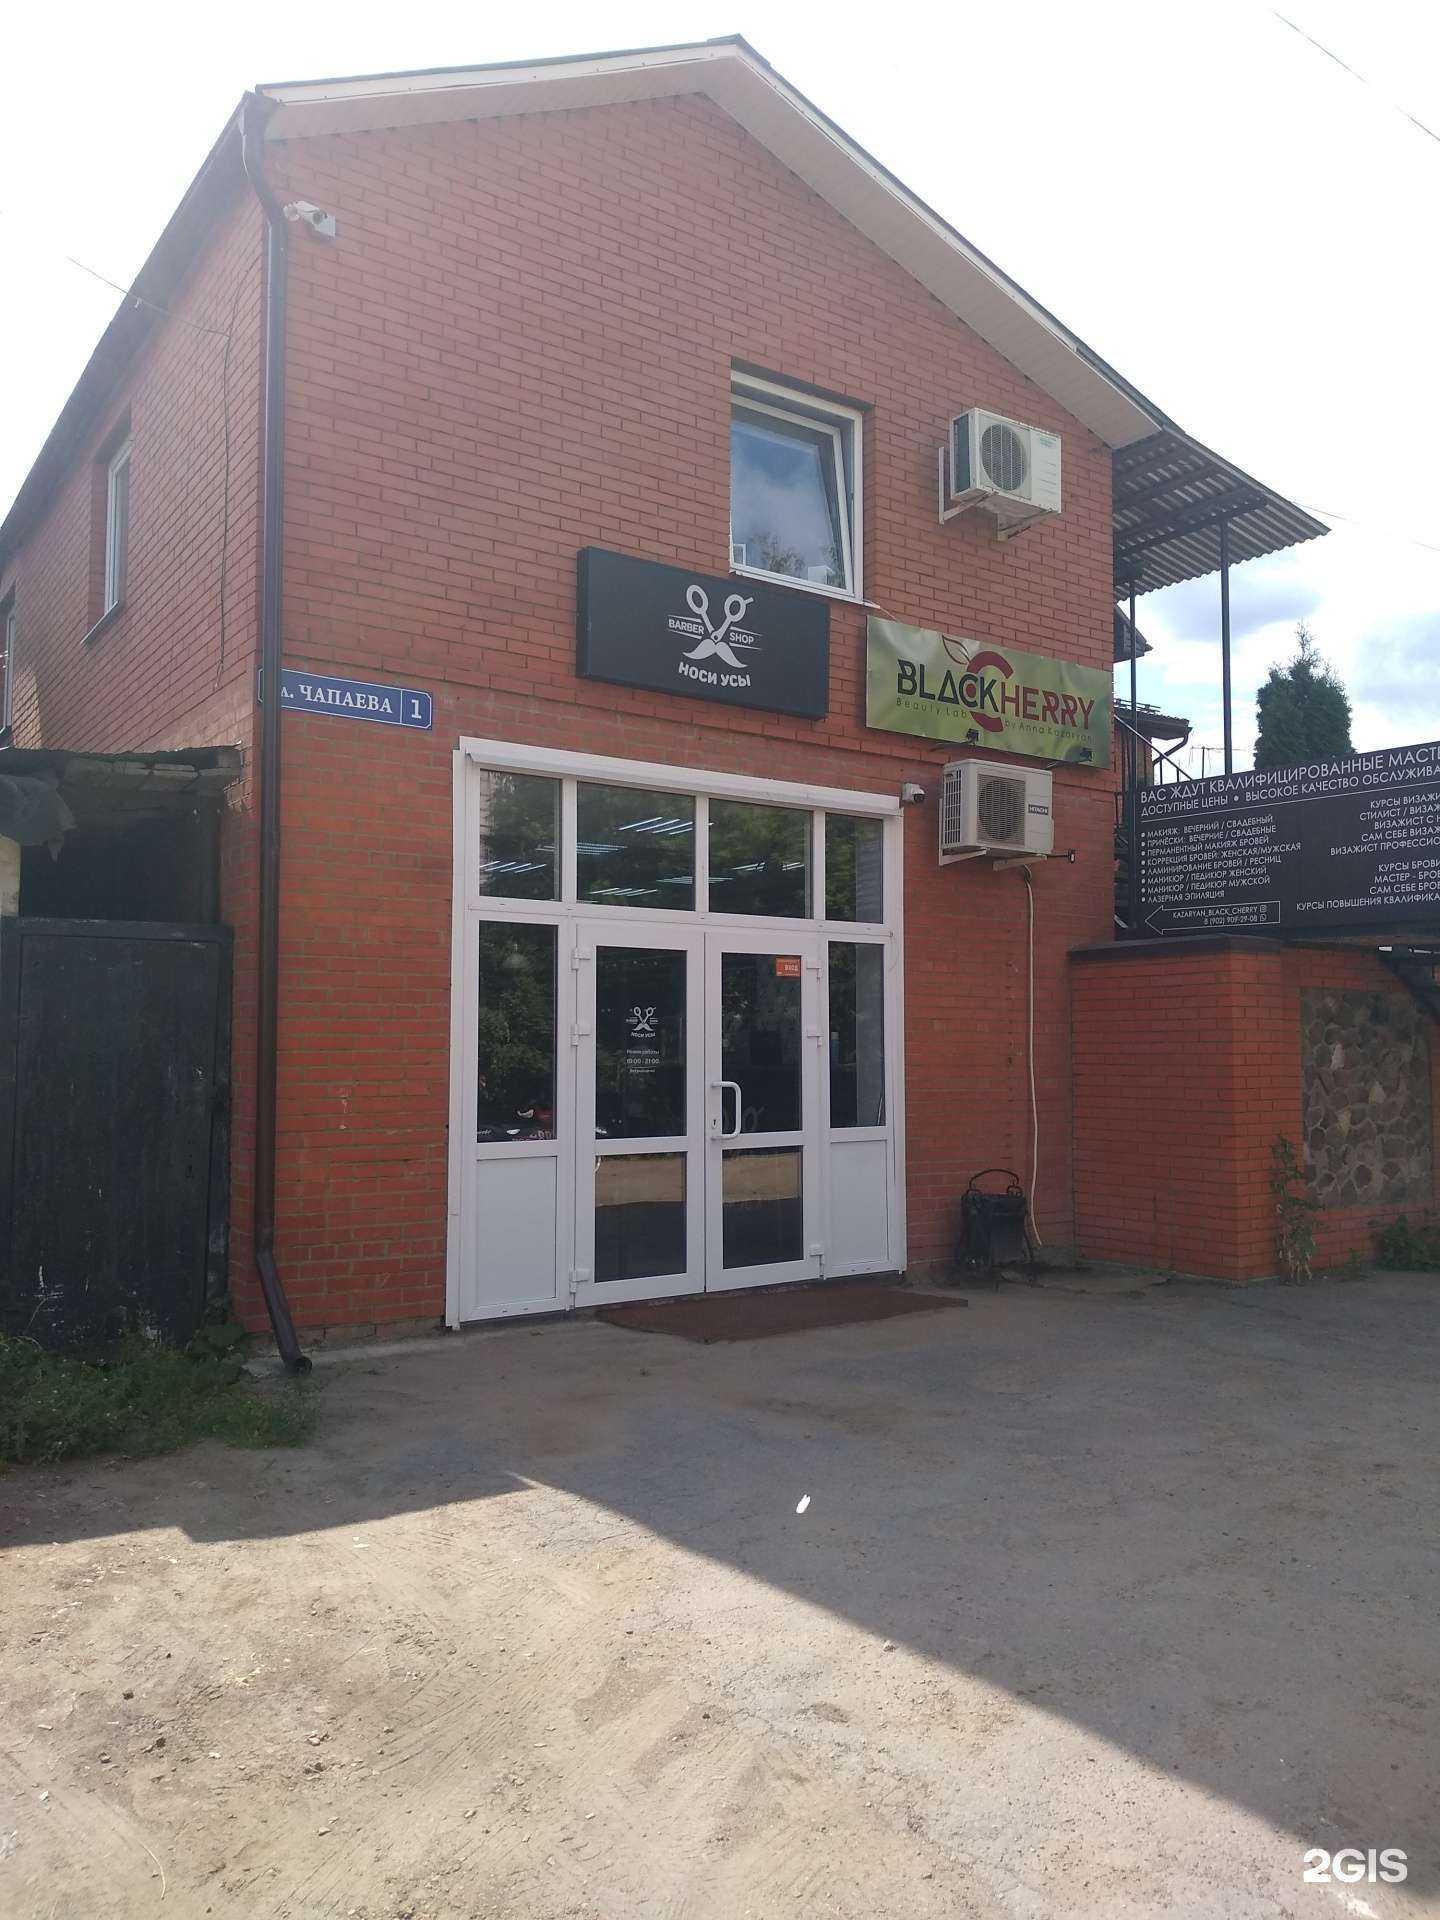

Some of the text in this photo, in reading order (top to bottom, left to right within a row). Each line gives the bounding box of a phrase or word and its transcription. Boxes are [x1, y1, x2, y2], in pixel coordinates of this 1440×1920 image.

[669, 617, 754, 645] BARBER SHOP
[678, 661, 751, 687] НОСИ УСЫ
[897, 658, 1000, 713] BLACK
[298, 684, 393, 714] ЧАПАЕВА
[411, 699, 422, 719] 1
[1141, 788, 1167, 803] ВАС
[1170, 781, 1206, 800] ЖДУТ
[1209, 754, 1384, 794] КВАЛИФИЦИРОВАННЫЕ
[1141, 799, 1199, 817] ДОСТУПНЫЕ
[1202, 795, 1228, 809] ЦЕНЫ
[1245, 785, 1299, 802] ВЫСОКОЕ
[1301, 776, 1359, 794] КАЧЕСТВО
[1370, 797, 1401, 809] КУРСЫ
[1029, 805, 1048, 814] HITACHI
[1360, 808, 1401, 821] СТИЛИСТ
[1183, 820, 1219, 834] ВЕЧЕРНИЙ
[1226, 814, 1273, 828] СВАДЕБНЫЙ
[1374, 816, 1423, 830] ВИЗАЖИСТ
[1426, 815, 1434, 824] С
[1189, 831, 1224, 842] ВЕЧЕРНИЕ
[1231, 825, 1276, 838] СВАДЕБНЫЕ
[1361, 832, 1383, 842] САМ
[1385, 828, 1408, 840] СЕБЕ
[1147, 834, 1269, 857] ПЕРМАНЕНТНЫЙ МАКИЯЖ БРОВЕЙ
[1330, 843, 1378, 856] ВИЗАЖИСТ
[1147, 854, 1188, 866] КОРРЕКЦИЯ
[1148, 863, 1212, 876] ЛАМИНИРОВАНИЕ
[1213, 857, 1243, 869] БРОВЕЙ
[1249, 855, 1281, 866] РЕСНИЦ
[1379, 861, 1409, 872] КУРСЫ
[1148, 874, 1184, 885] МАНИКЮР
[1191, 870, 1227, 881] ПЕДИКЮР
[1229, 865, 1267, 878] ЖЕНСКИЙ
[1374, 872, 1410, 884] МАСТЕР
[1148, 883, 1184, 894] МАНИКЮР
[1191, 879, 1227, 890] ПЕДИКЮР
[1229, 875, 1270, 888] МУЖСКОЙ
[1369, 885, 1391, 895] САМ
[1393, 883, 1416, 893] СЕБЕ
[1148, 890, 1225, 904] ЛАЗЕРНАЯ ЭПИЛЯЦИЯ
[1296, 900, 1325, 911] КУРСЫ
[1326, 896, 1382, 909] ПОВЫШЕНИЯ
